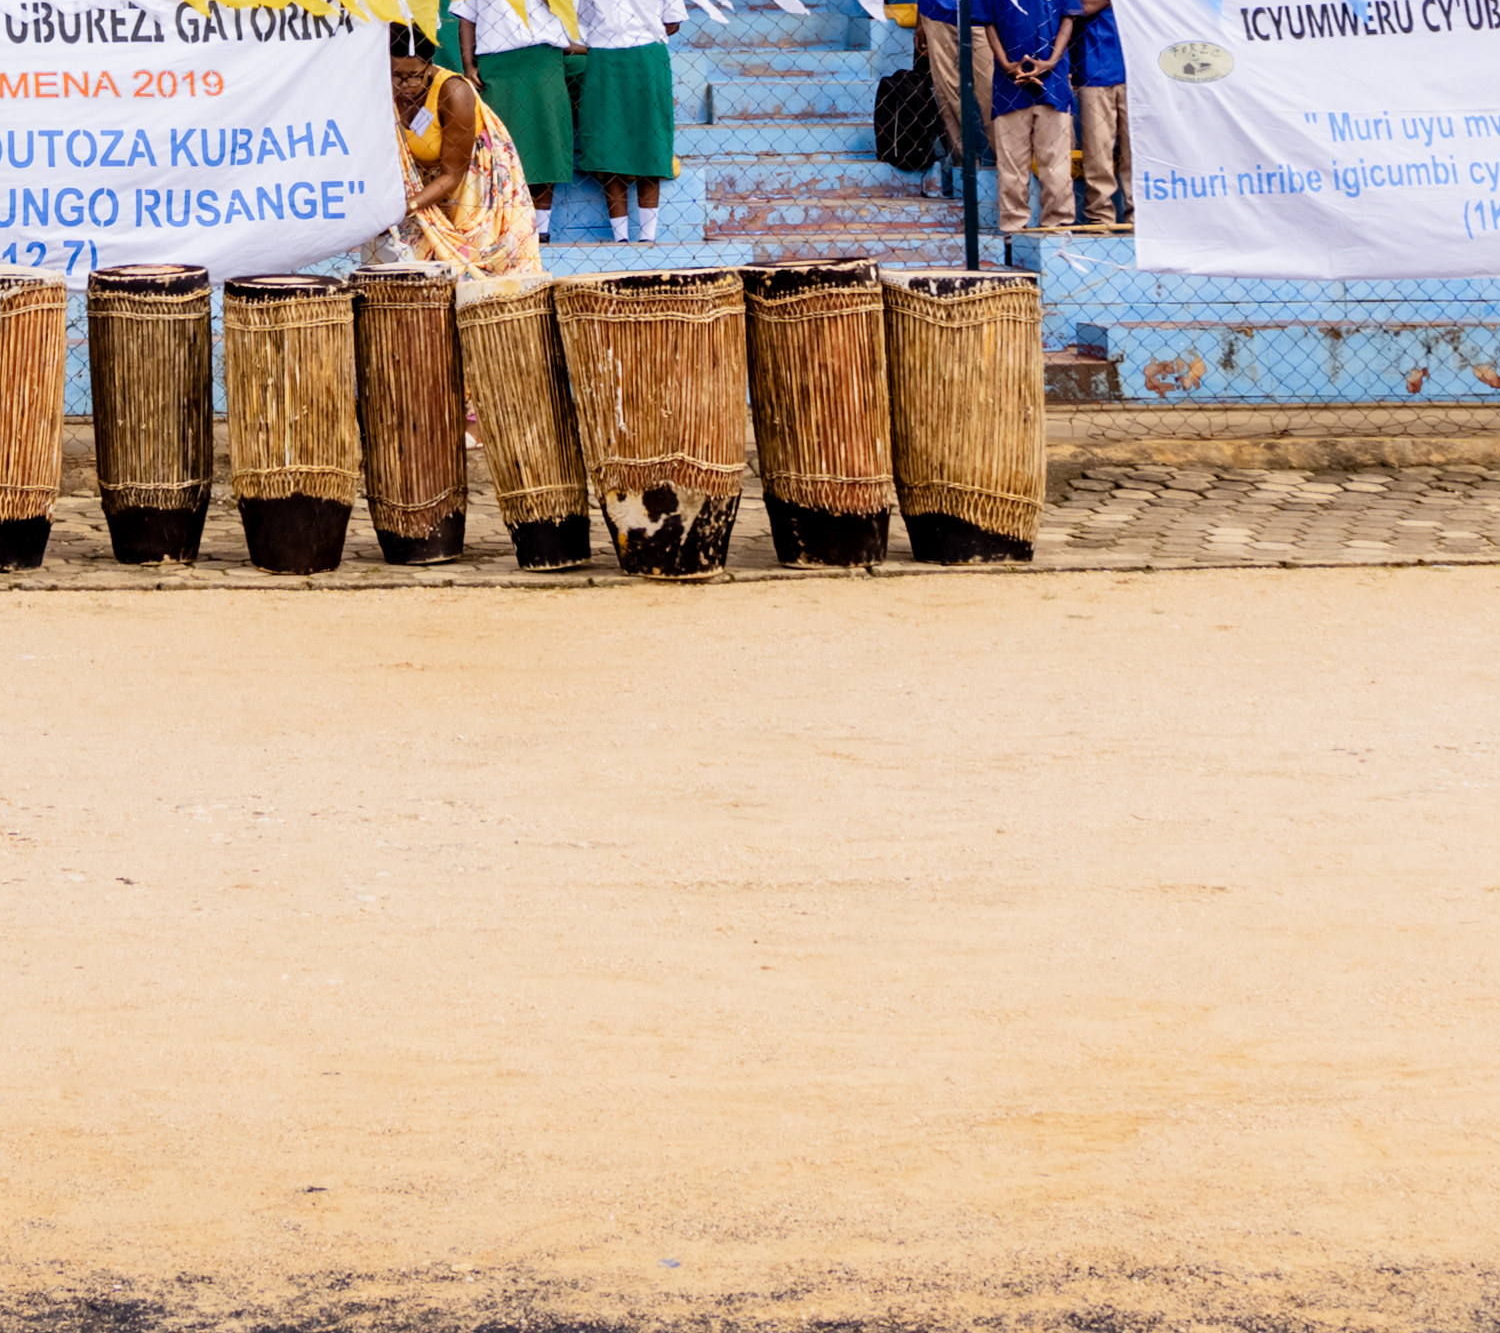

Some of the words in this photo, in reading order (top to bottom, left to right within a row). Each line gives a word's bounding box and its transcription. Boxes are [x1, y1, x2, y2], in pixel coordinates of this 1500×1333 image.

[1240, 0, 1414, 42] ICYUMWERU
[132, 69, 225, 98] 2019
[170, 119, 350, 167] KUBAHA
[1328, 111, 1393, 142] Muri
[1402, 116, 1455, 147] uyu
[1144, 167, 1229, 201] Ishuri
[1237, 164, 1323, 195] niribe
[1332, 154, 1459, 198] igicumbi
[136, 181, 365, 228] RUSANGE"
